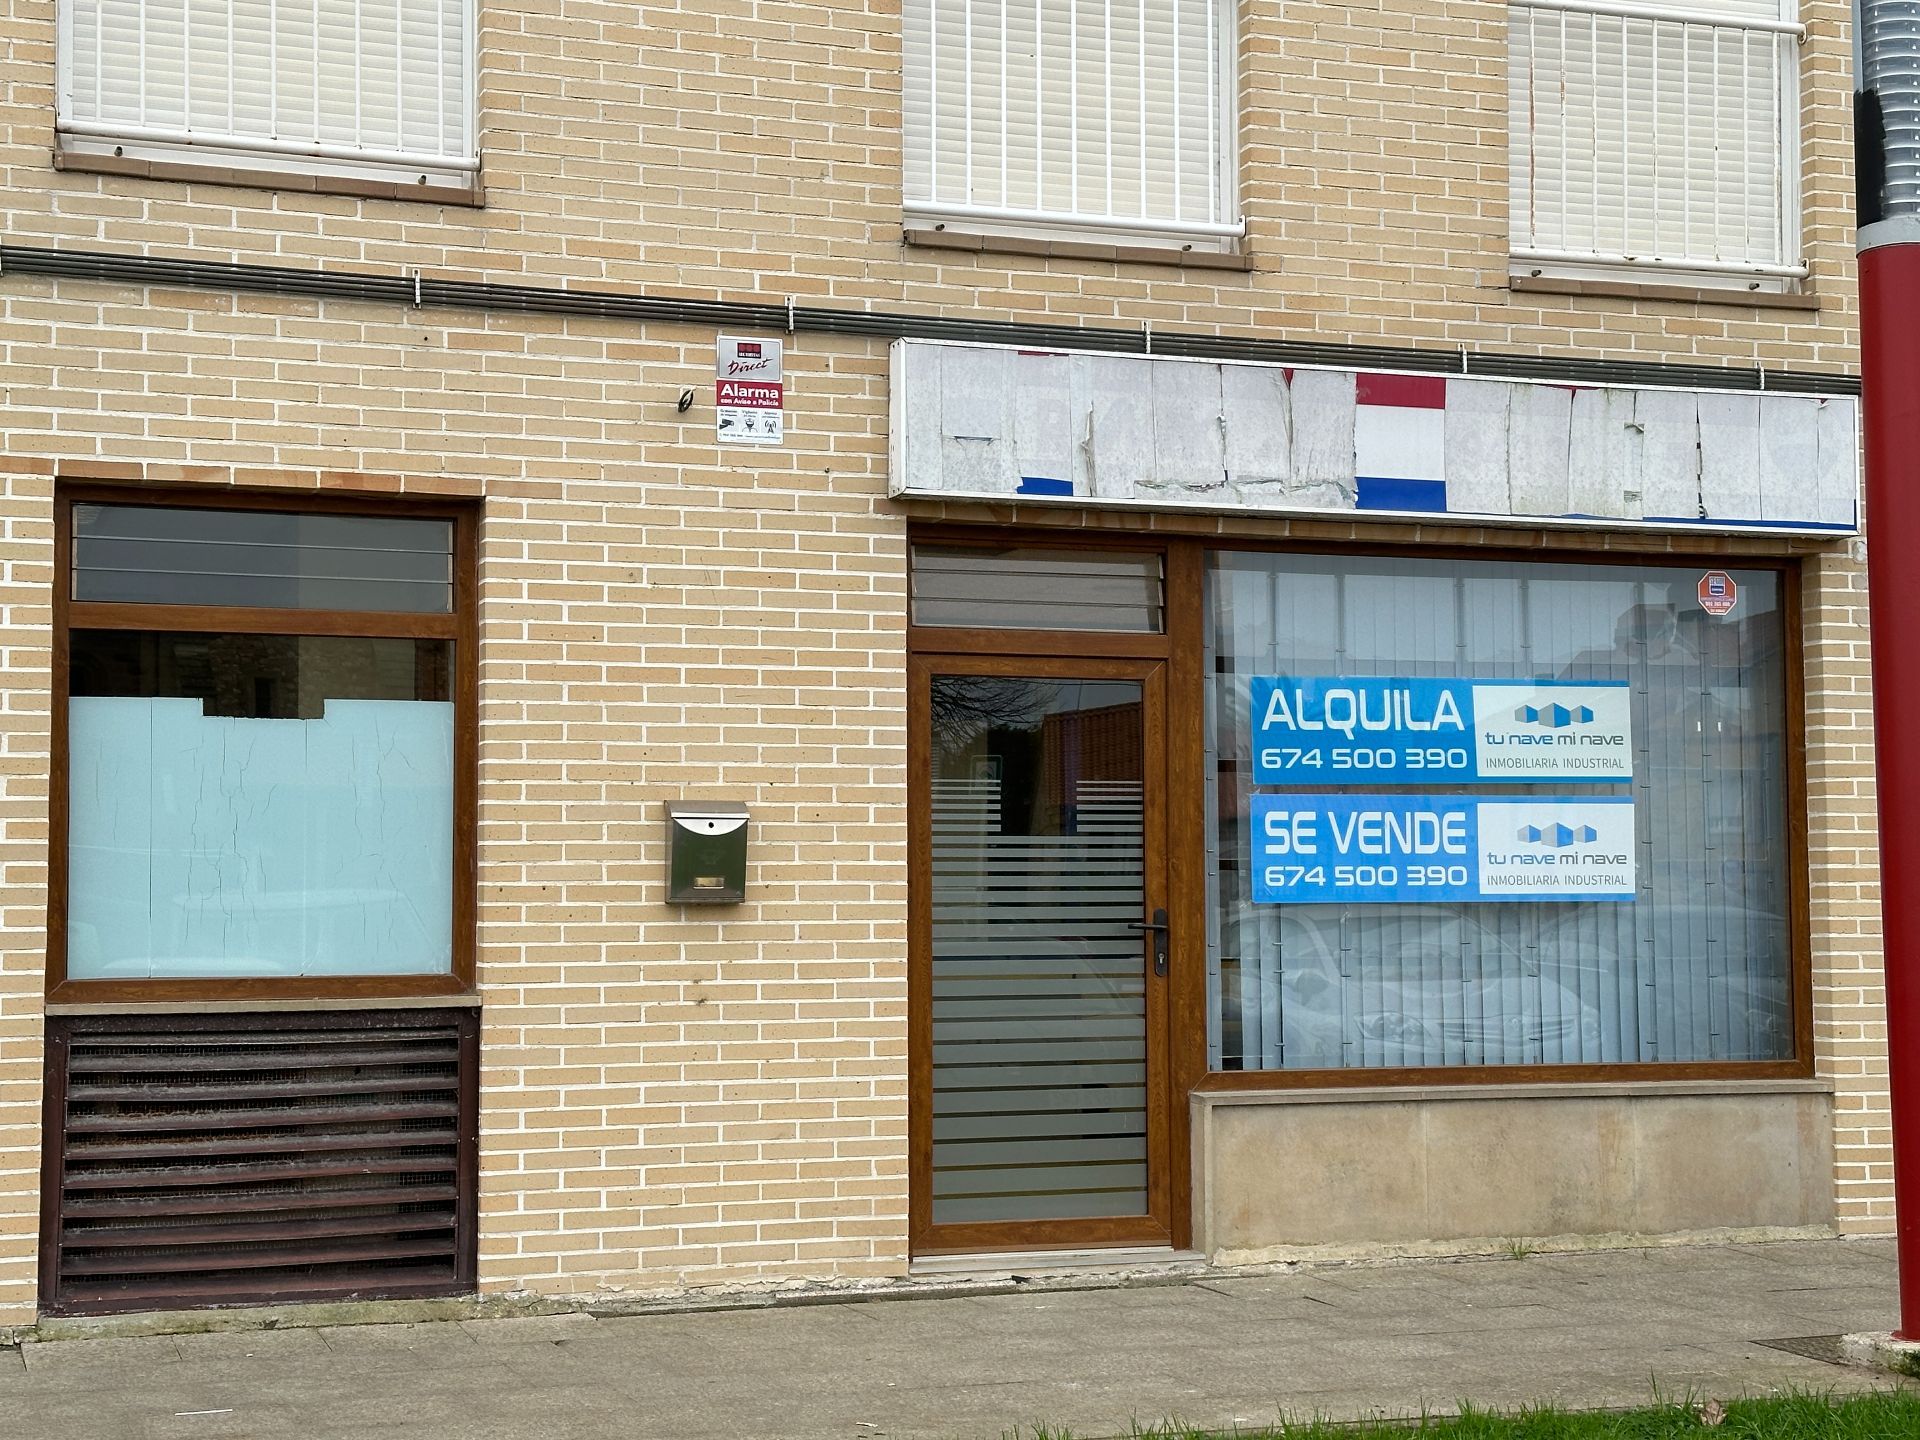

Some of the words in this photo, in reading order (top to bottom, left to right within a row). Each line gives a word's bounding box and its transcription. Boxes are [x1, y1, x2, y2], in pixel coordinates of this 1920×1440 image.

[728, 358, 774, 376] Direct
[720, 383, 779, 399] Alarma
[733, 397, 752, 405] Aviso
[1261, 688, 1465, 740] ALQUILA
[1484, 731, 1507, 746] tu
[1508, 733, 1553, 746] nave
[1557, 731, 1576, 746] mi
[1580, 734, 1624, 746] nave
[1261, 748, 1323, 769] 674
[1331, 748, 1397, 769] 500
[1405, 748, 1467, 769] 390
[1485, 757, 1559, 769] INMOBILIARIA
[1562, 757, 1624, 769] INDUSTRIAL
[1264, 811, 1317, 855] SE
[1327, 811, 1467, 855] VENDE
[1487, 851, 1507, 865] tu
[1510, 853, 1555, 865] nave
[1559, 851, 1579, 865] mi
[1582, 853, 1627, 866] nave
[1264, 865, 1326, 886] 674
[1334, 865, 1398, 886] 500
[1406, 865, 1468, 886] 390
[1487, 874, 1560, 887] INMOBILIARIA
[1564, 874, 1628, 886] INDUSTRIAL
